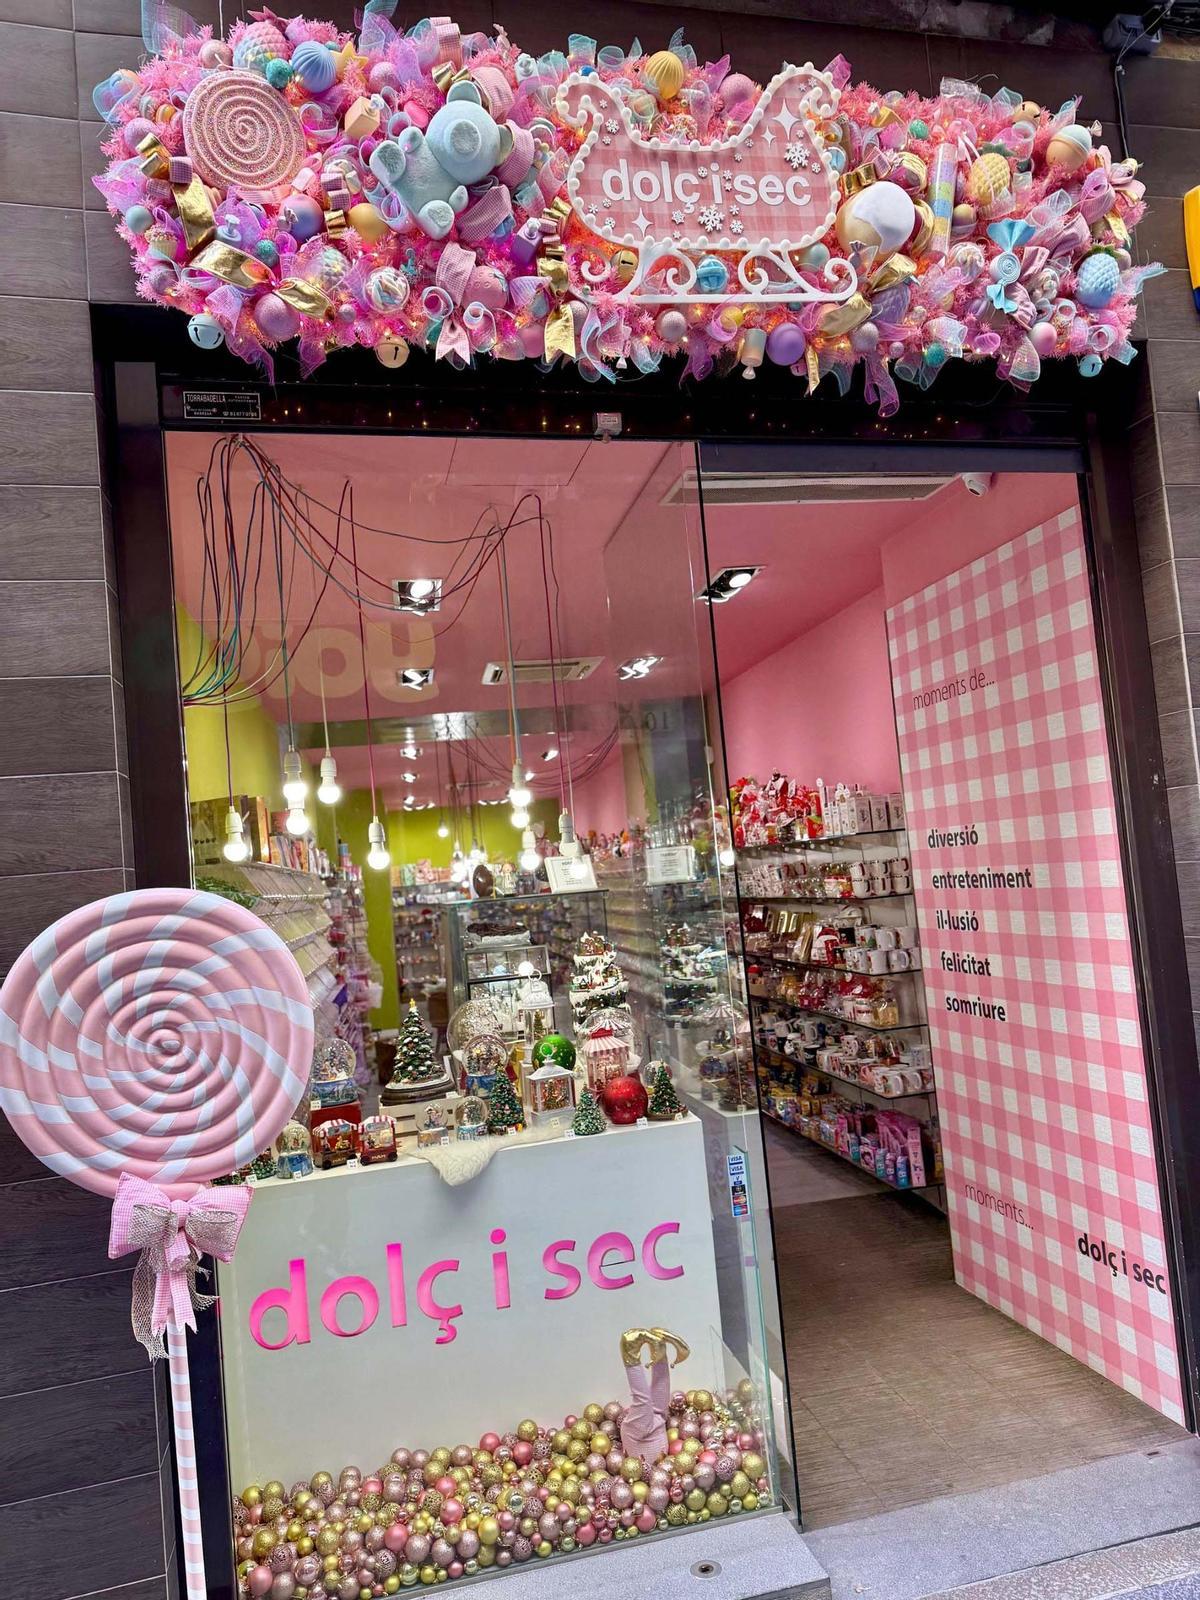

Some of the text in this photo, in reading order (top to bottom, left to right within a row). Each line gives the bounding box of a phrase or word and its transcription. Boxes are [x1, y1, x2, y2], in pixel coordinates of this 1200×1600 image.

[601, 158, 812, 214] dolç i sec
[913, 668, 995, 711] moments de...
[928, 824, 979, 849] diversió
[932, 867, 1033, 889] entreteniment
[936, 909, 979, 932] il·lusió
[941, 951, 992, 977] felicitat
[945, 995, 1006, 1022] somriure
[964, 1183, 1034, 1230] moments...
[1077, 1232, 1167, 1295] dolç i sec
[248, 1221, 686, 1351] dolç i sec
